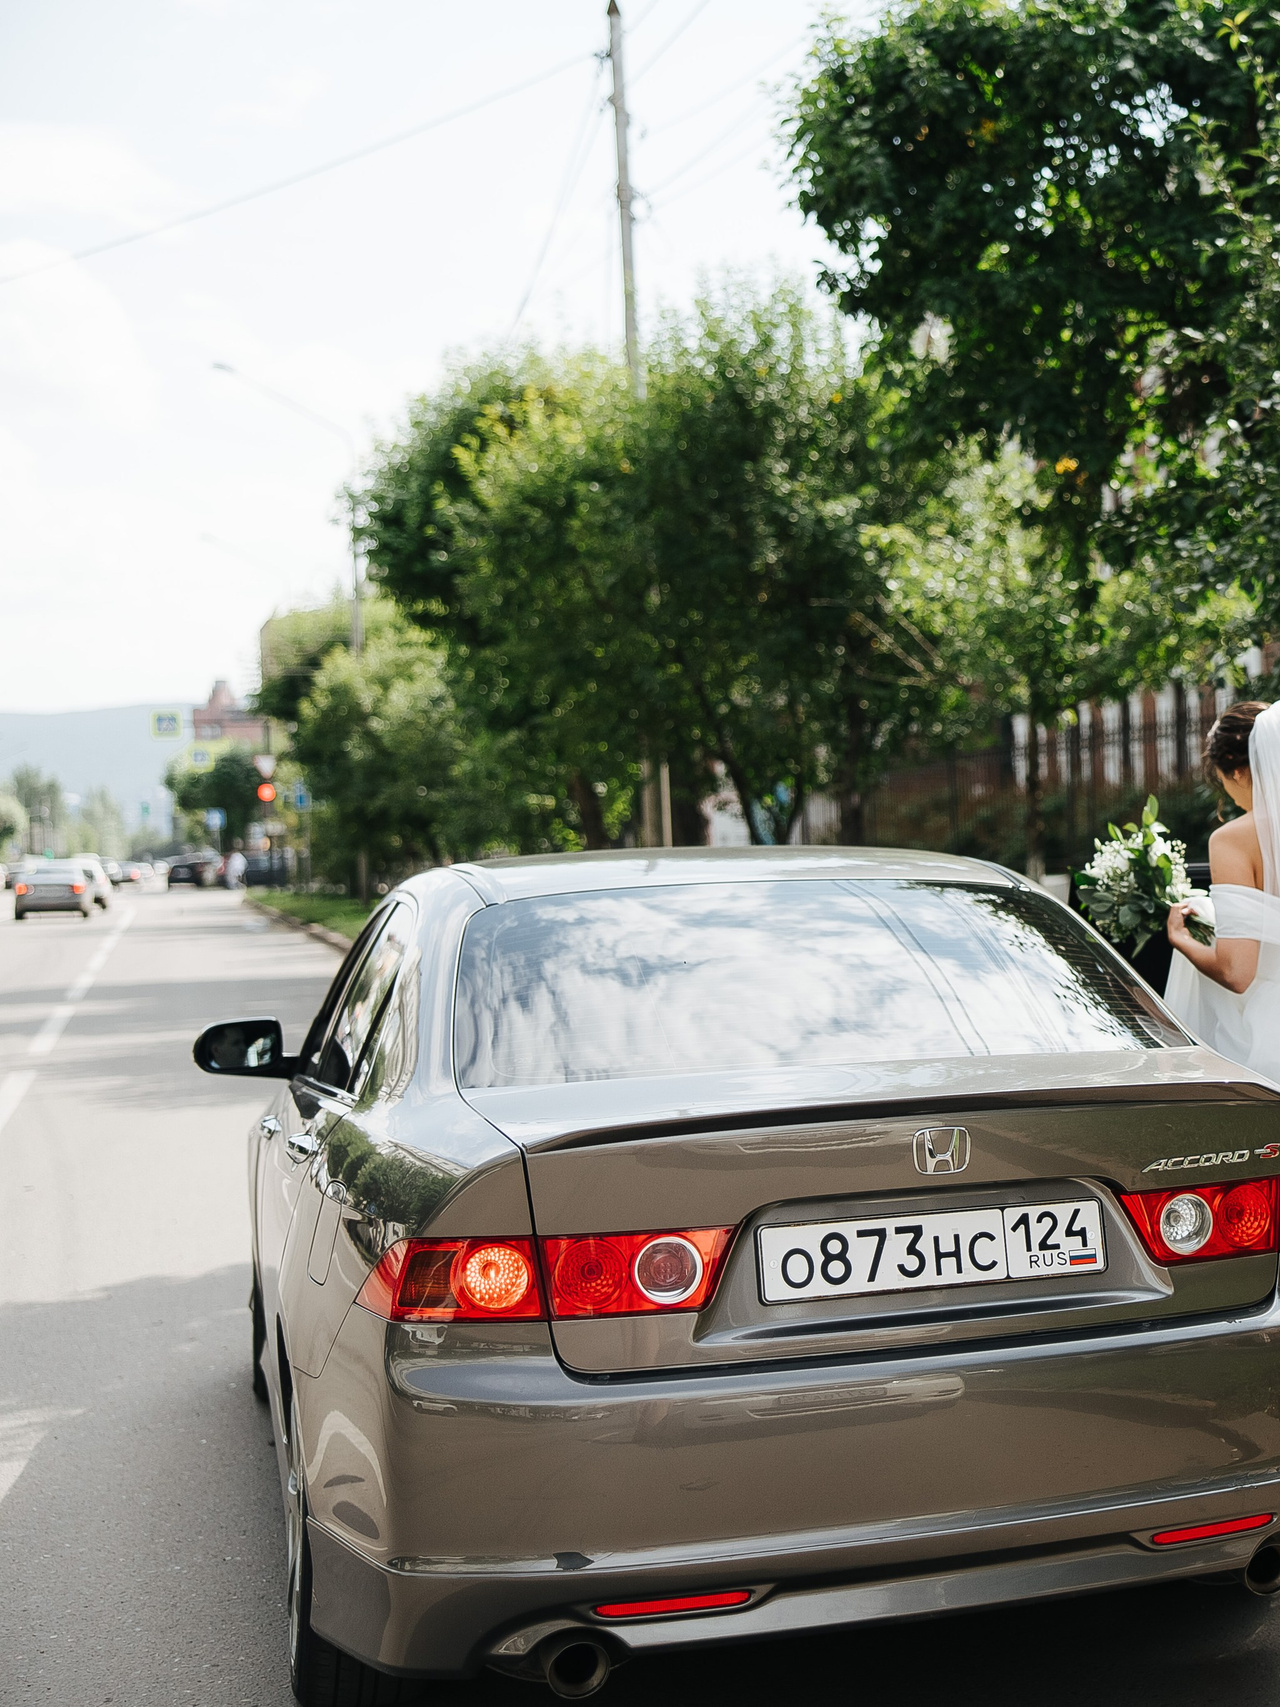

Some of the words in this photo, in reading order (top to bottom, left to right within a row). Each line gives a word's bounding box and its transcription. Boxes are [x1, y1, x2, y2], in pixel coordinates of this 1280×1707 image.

[1141, 1149, 1250, 1173] ACCORD
[1010, 1208, 1088, 1252] 124
[1029, 1252, 1067, 1269] RUS
